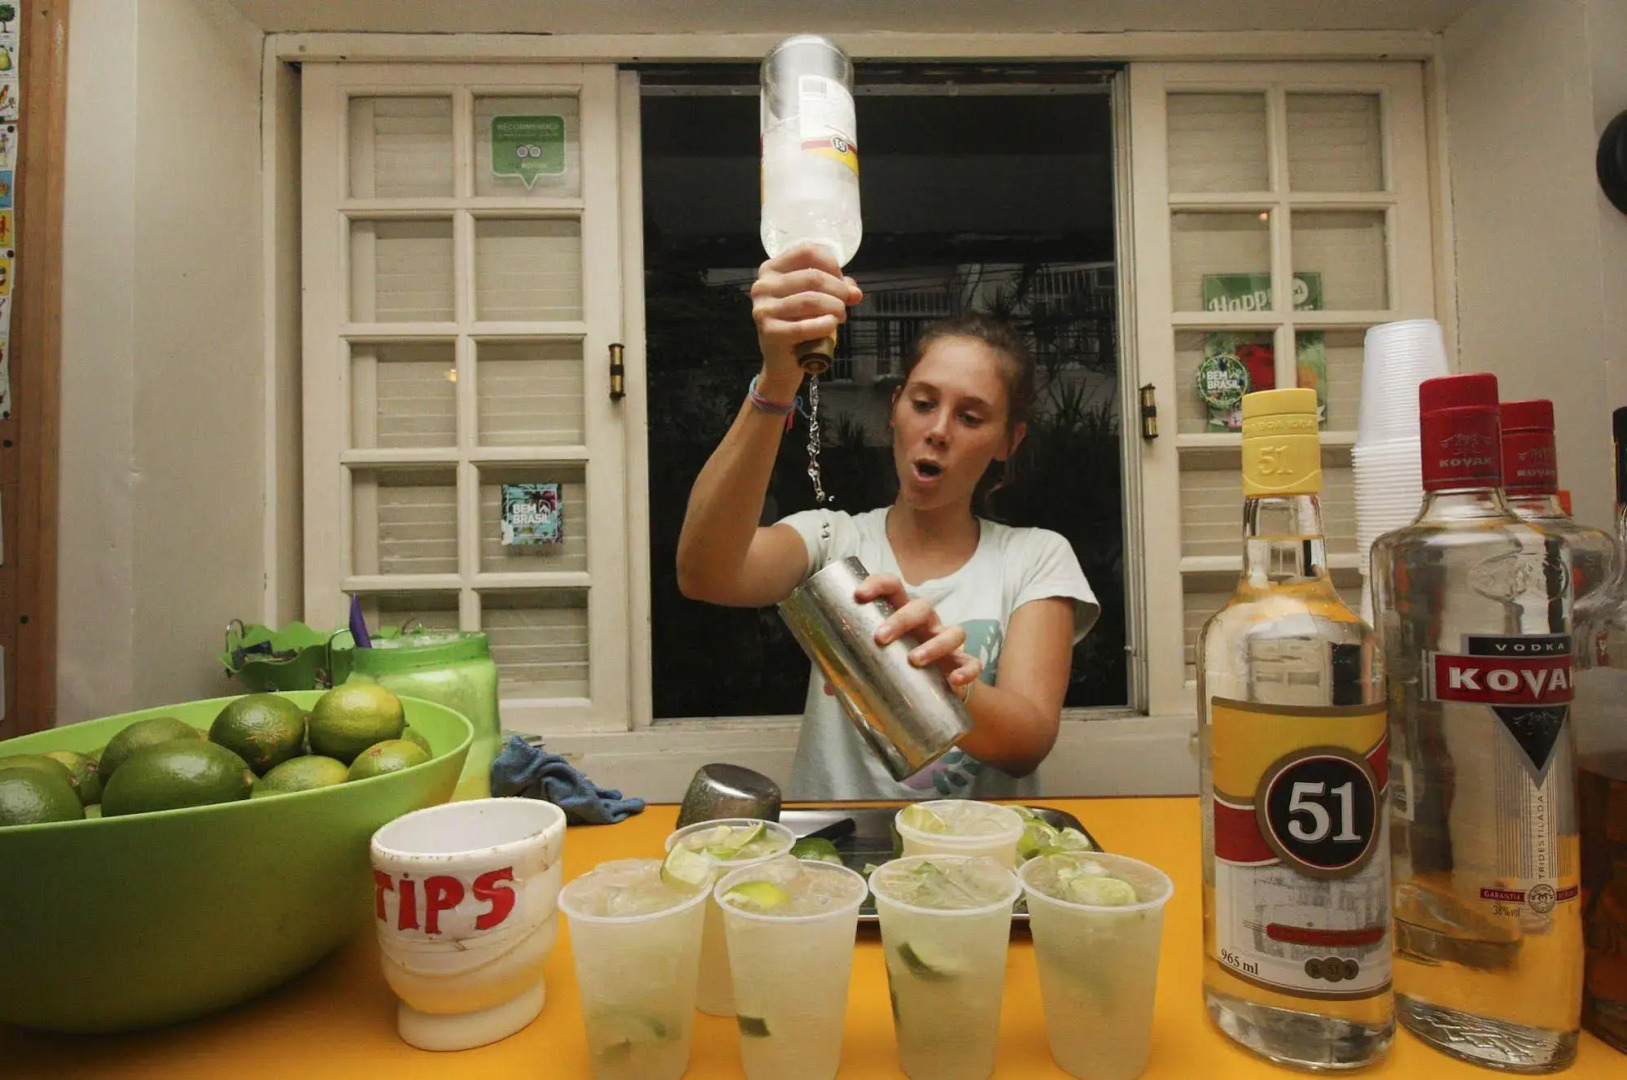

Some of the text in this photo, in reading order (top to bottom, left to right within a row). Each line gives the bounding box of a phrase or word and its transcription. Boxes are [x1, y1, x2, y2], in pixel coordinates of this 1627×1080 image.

[833, 138, 847, 152] 51
[1209, 288, 1272, 312] Happ
[1207, 371, 1228, 380] BEM
[1207, 380, 1241, 390] BRASIL
[1258, 445, 1294, 474] 51
[1439, 457, 1492, 468] KOVAK
[513, 503, 537, 513] BEM
[513, 514, 551, 524] BRASIL
[1495, 643, 1565, 651] VODKA
[1288, 781, 1362, 843] 51
[1537, 795, 1545, 879] TRIDESTILADA
[1221, 949, 1259, 975] 965 ml
